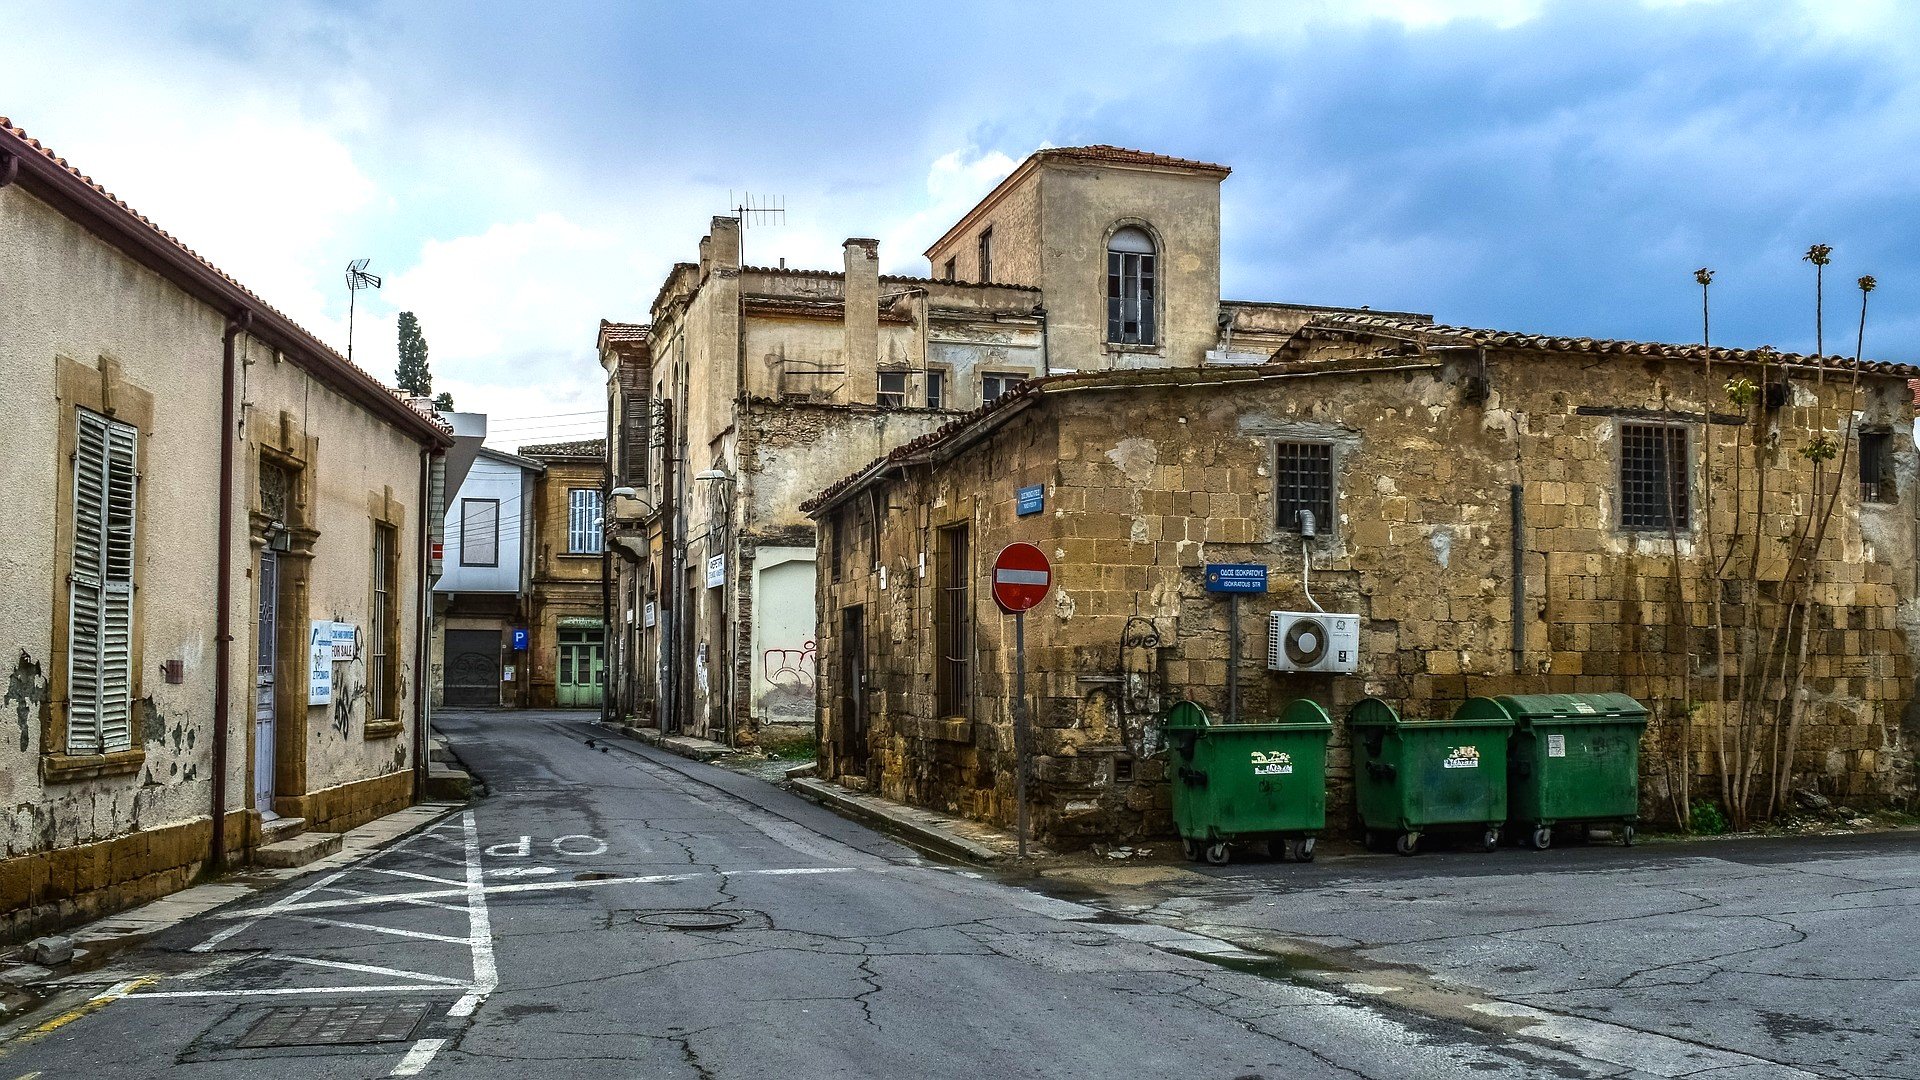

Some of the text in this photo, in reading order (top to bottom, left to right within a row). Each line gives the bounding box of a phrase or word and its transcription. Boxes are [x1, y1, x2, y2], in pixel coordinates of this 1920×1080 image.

[515, 632, 524, 642] P
[332, 645, 352, 658] FOR SALE
